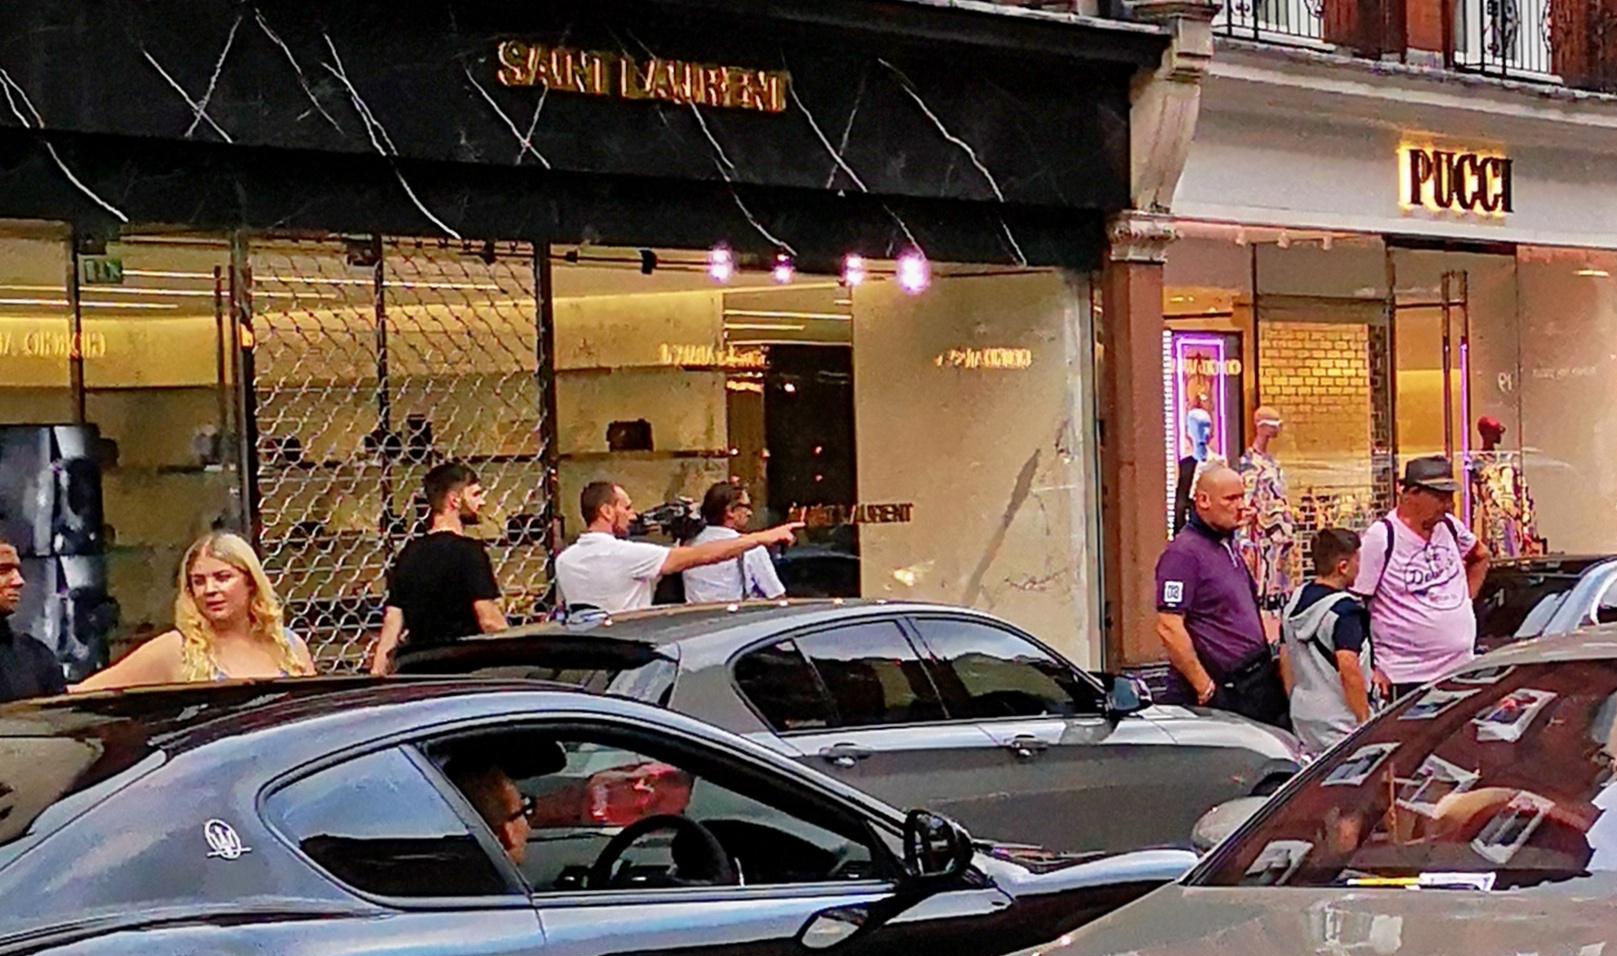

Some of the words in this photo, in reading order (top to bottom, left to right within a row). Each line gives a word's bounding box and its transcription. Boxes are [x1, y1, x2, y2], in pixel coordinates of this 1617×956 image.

[498, 41, 607, 93] SAINT
[620, 57, 786, 112] LAURENT
[1409, 149, 1514, 213] PUCCI
